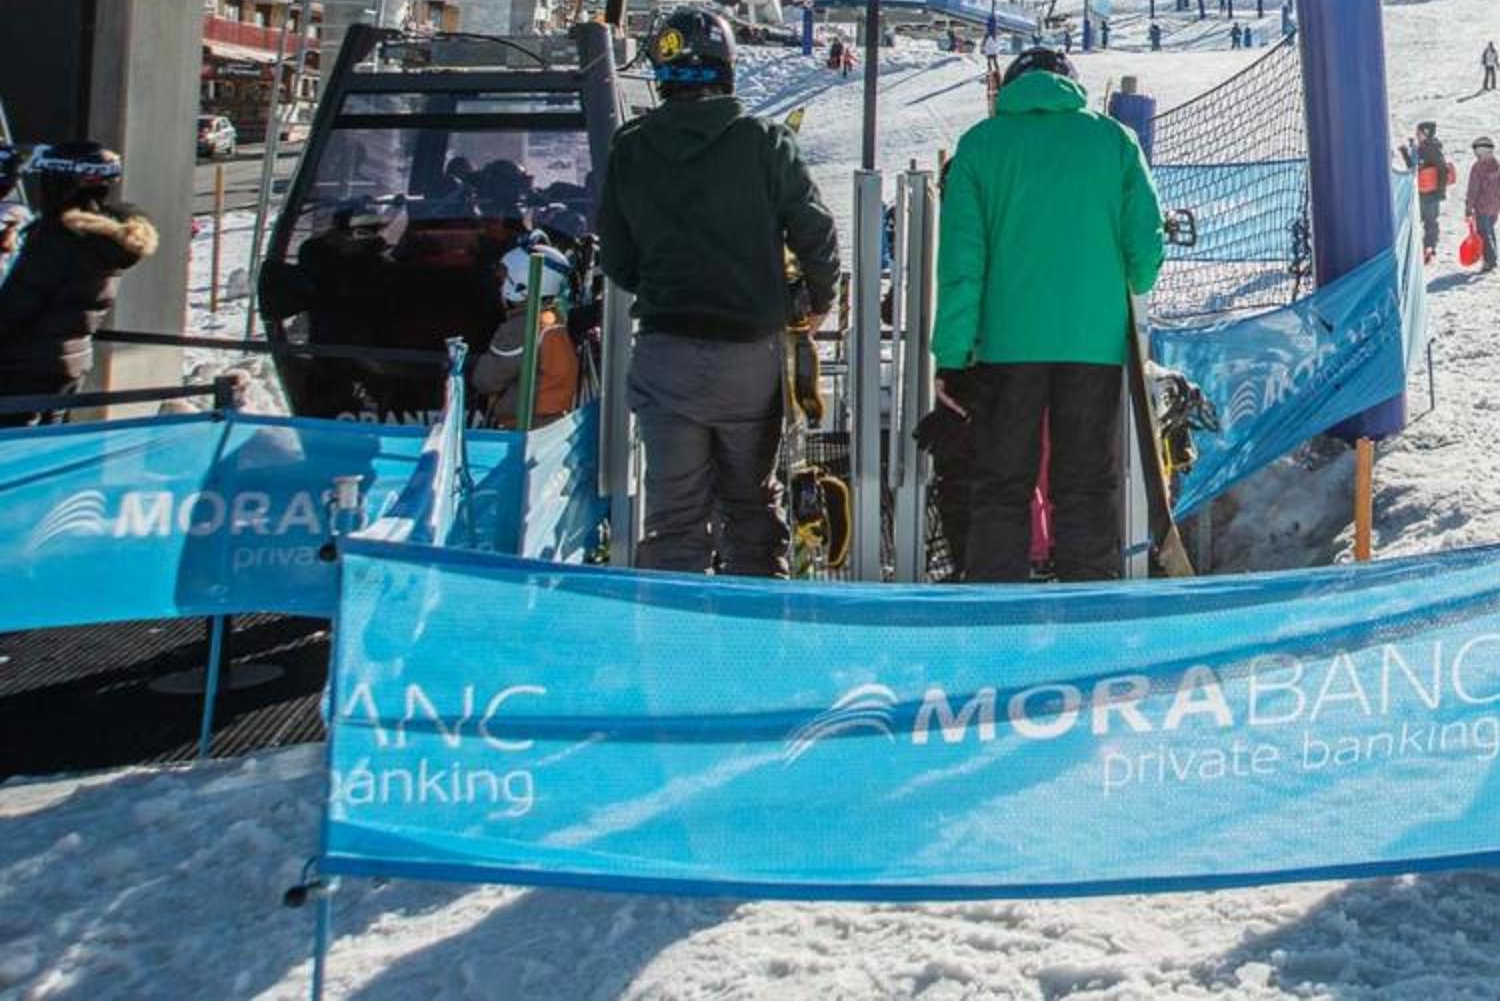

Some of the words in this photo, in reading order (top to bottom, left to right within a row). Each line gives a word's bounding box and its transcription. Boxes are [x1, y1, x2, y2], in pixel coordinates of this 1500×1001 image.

[112, 489, 340, 538] MORA
[233, 542, 330, 573] priva
[1101, 740, 1281, 795] private
[1303, 715, 1500, 772] banking
